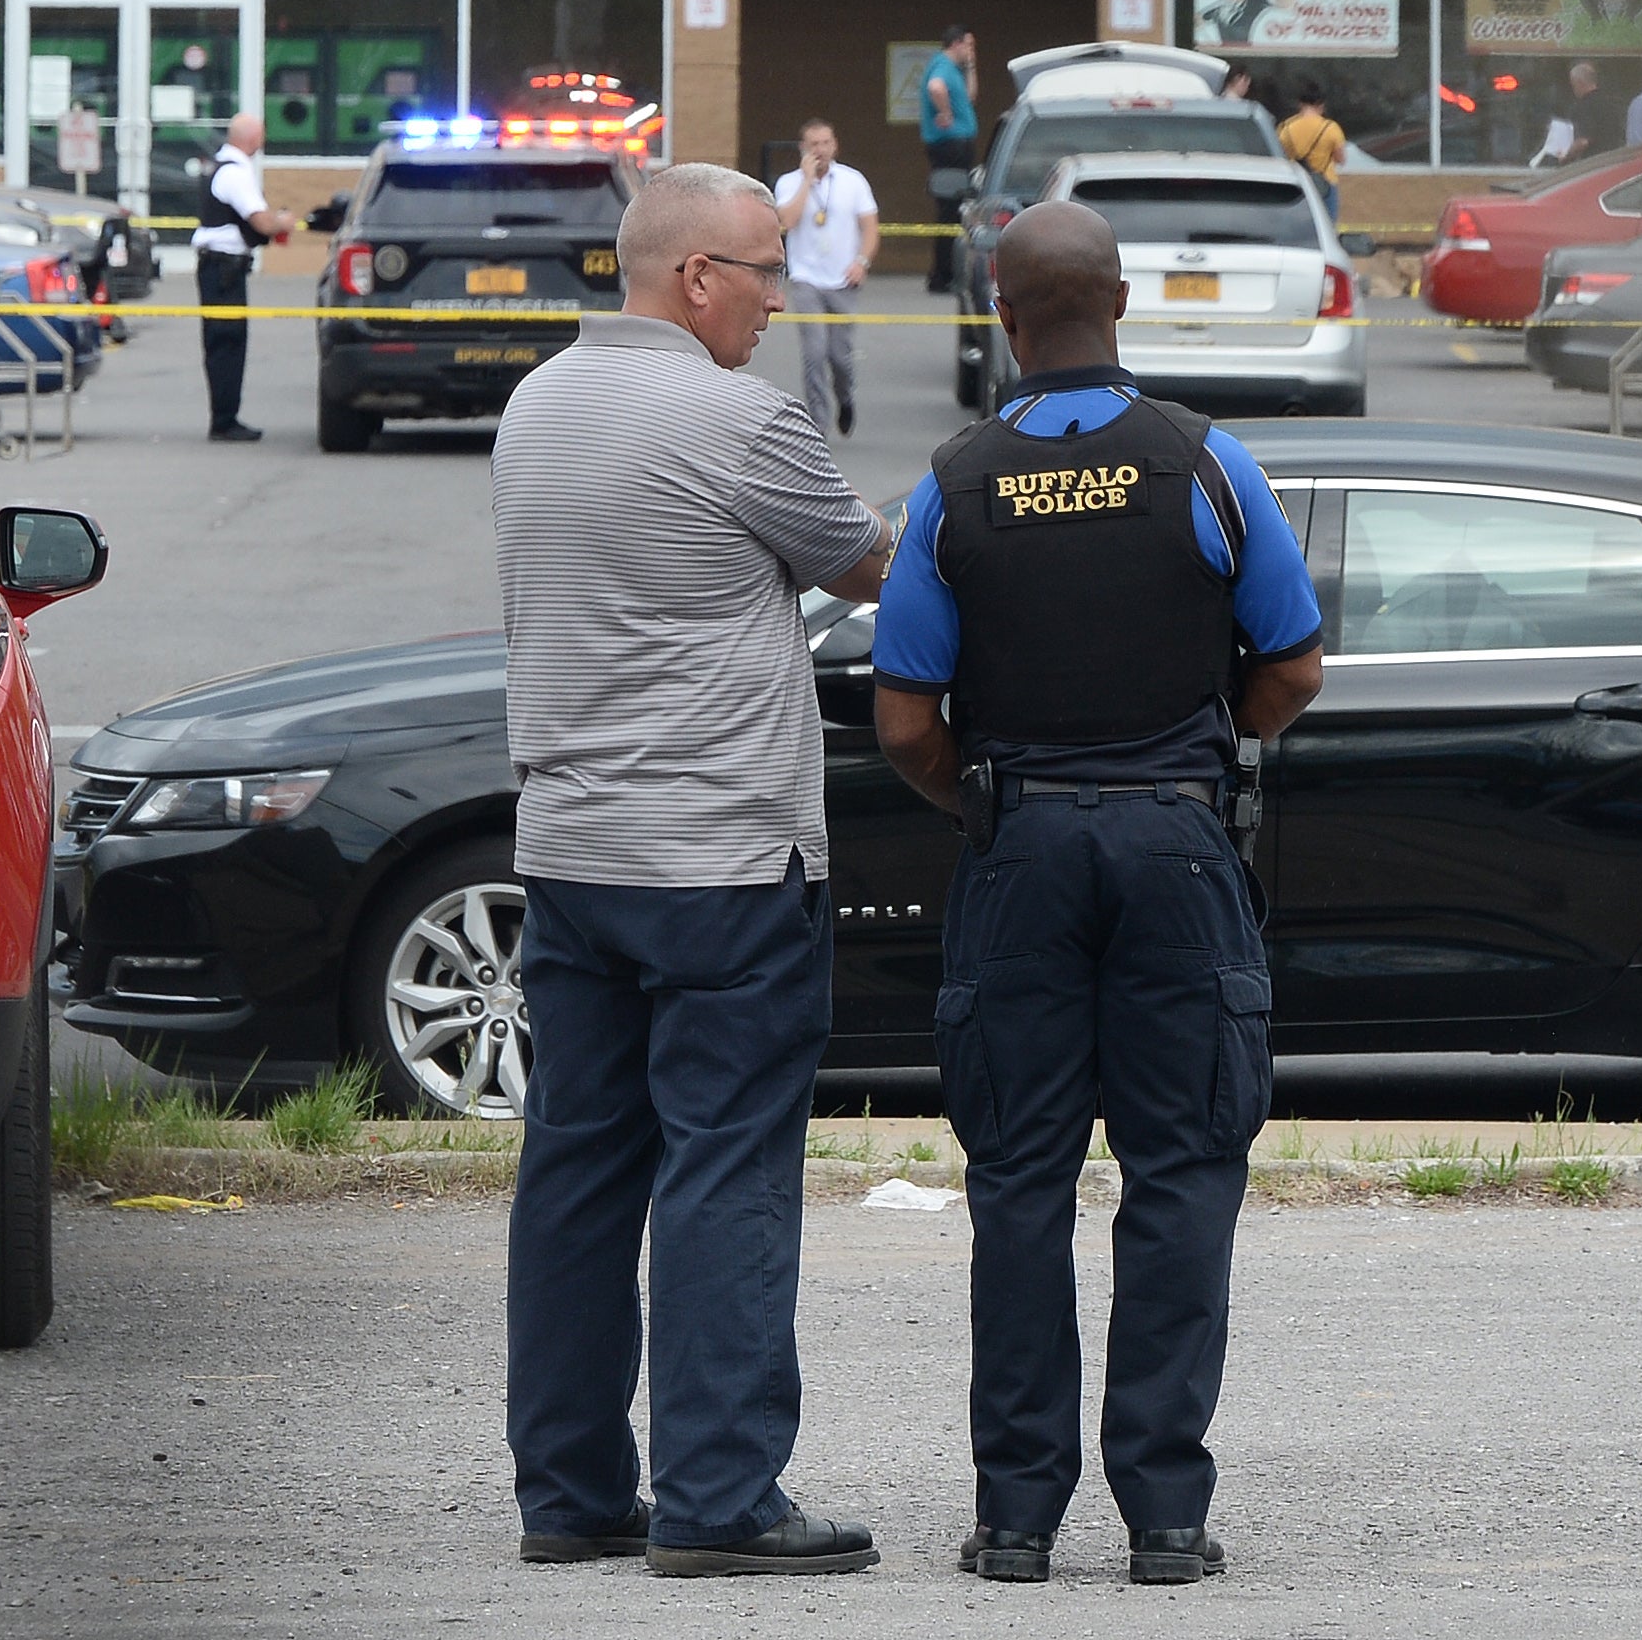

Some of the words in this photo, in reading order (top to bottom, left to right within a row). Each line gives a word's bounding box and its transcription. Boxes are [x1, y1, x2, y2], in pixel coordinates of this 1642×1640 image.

[996, 465, 1139, 497] BUFFALO
[1012, 487, 1127, 516] POLICE
[839, 905, 922, 919] PALA
